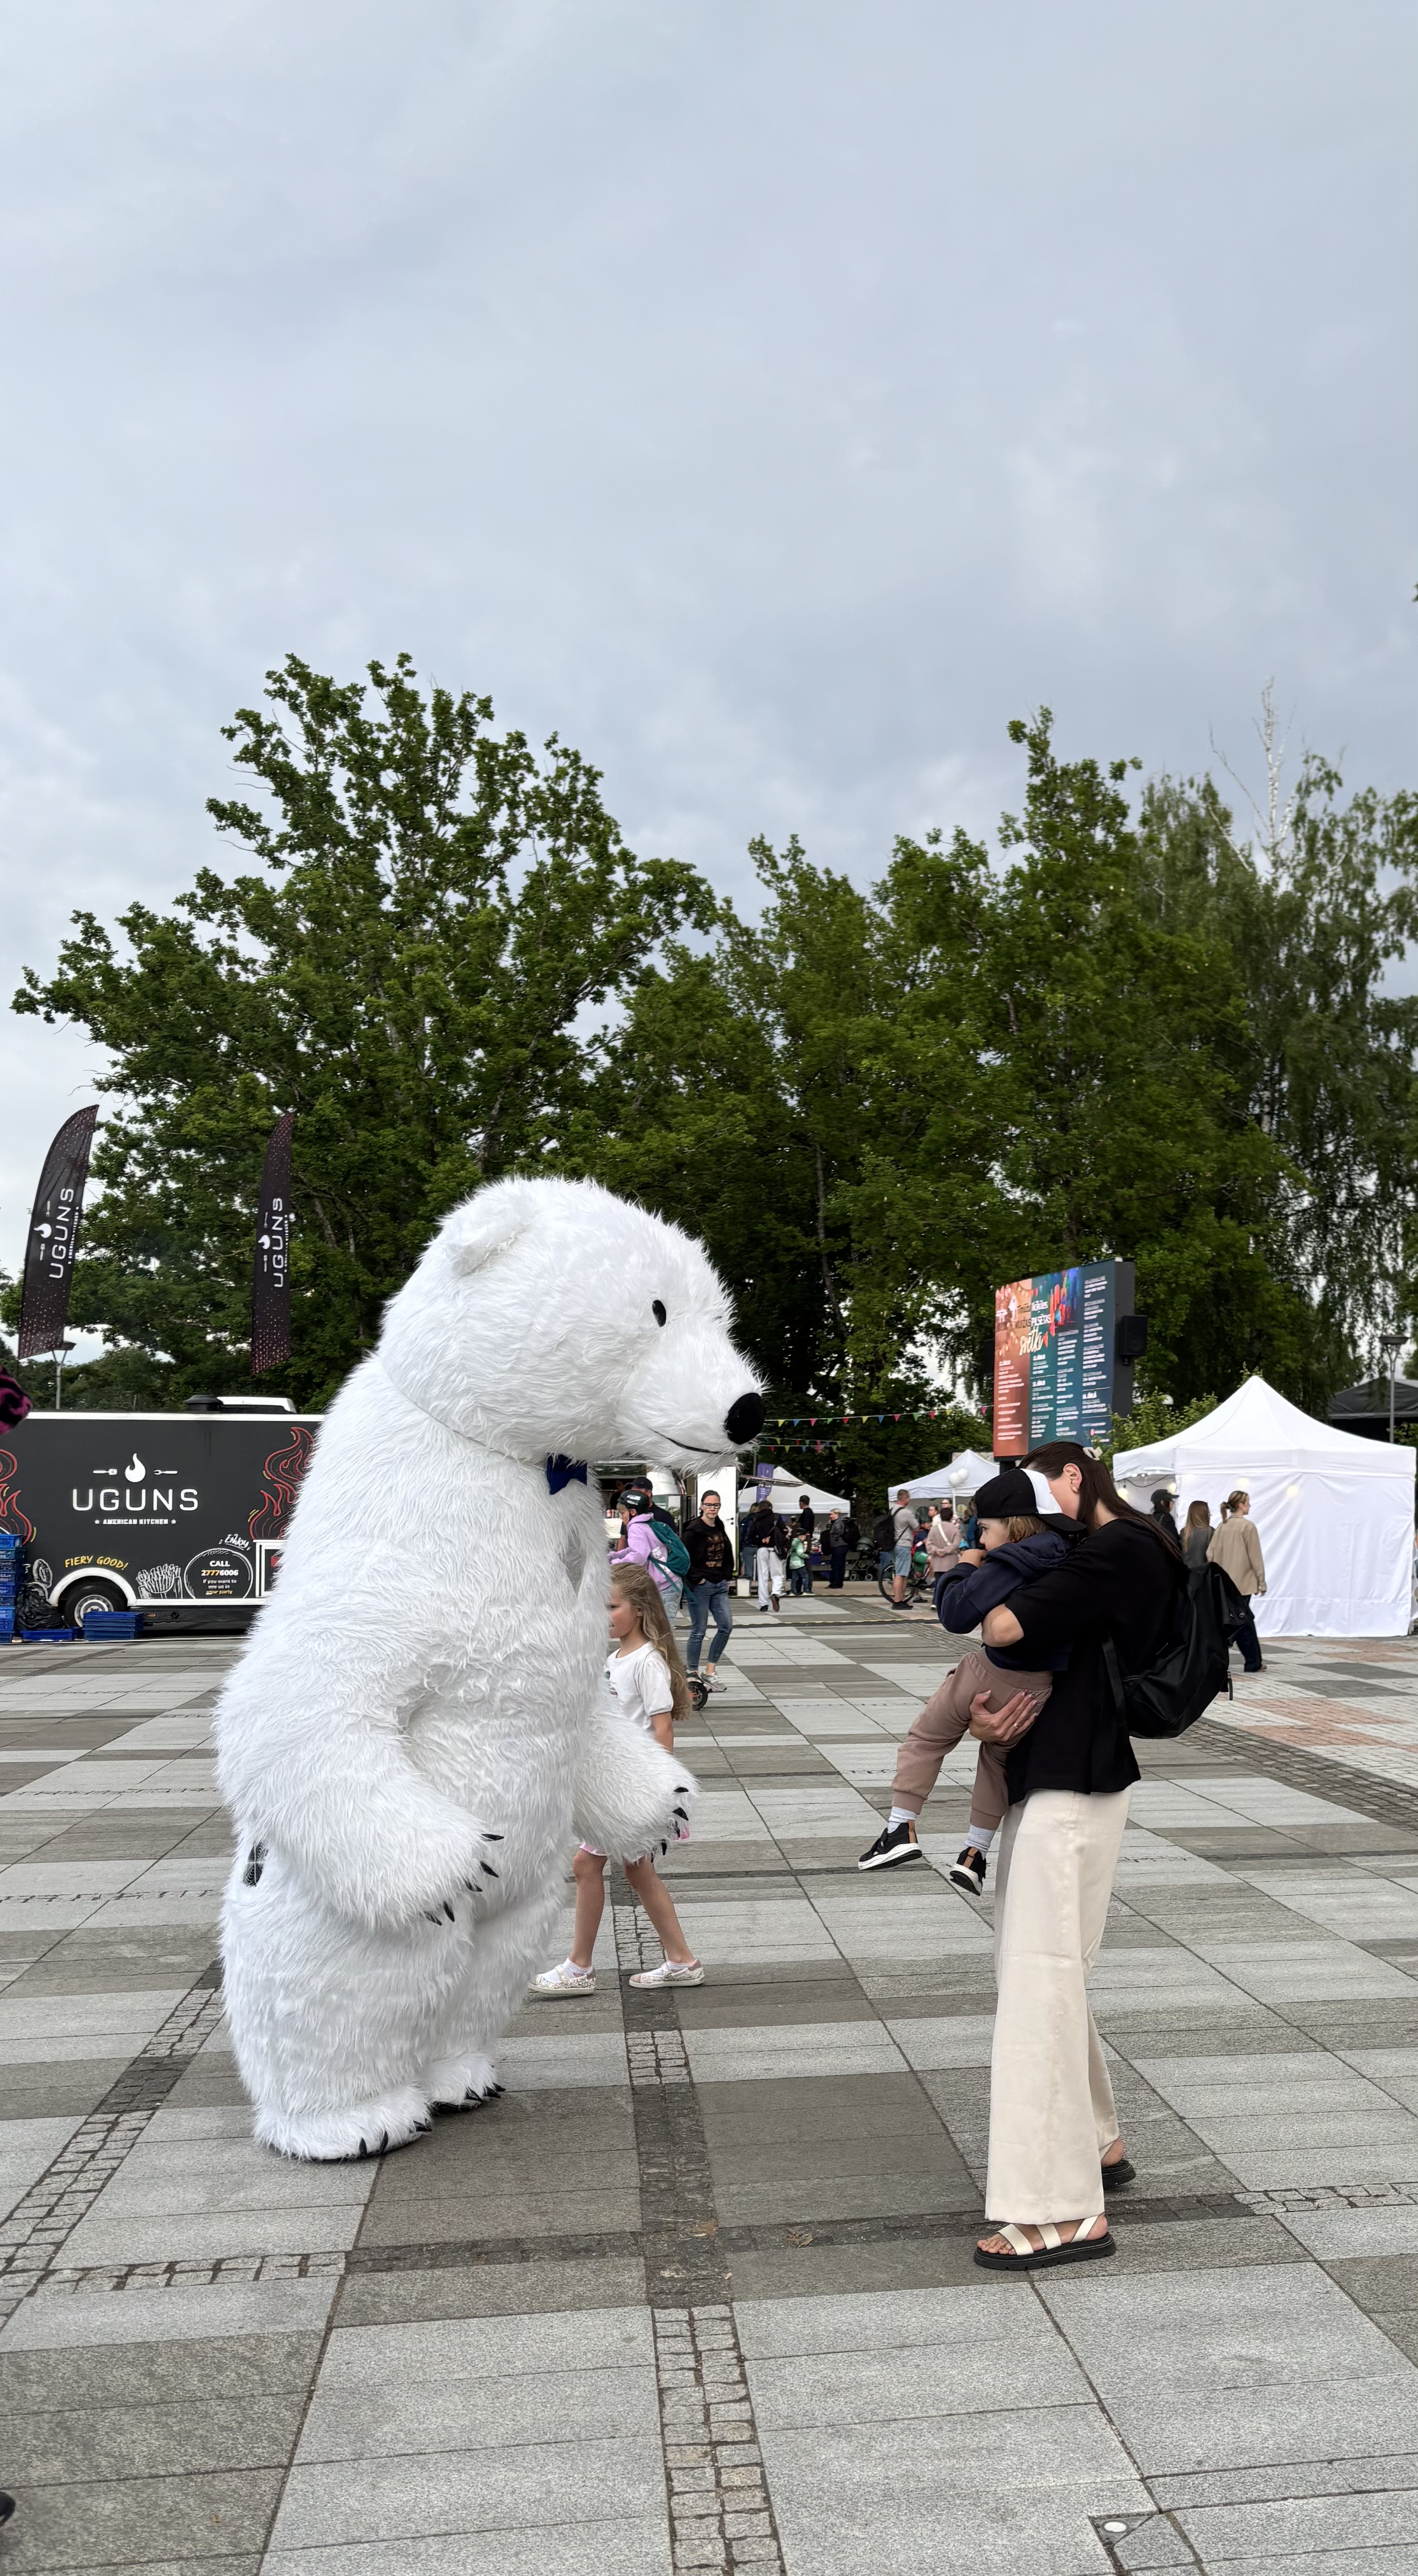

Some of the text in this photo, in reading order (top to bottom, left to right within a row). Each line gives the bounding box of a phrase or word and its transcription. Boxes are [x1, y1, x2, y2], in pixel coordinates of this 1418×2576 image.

[49, 1189, 74, 1278] UGUNS
[272, 1198, 283, 1287] UGUNS
[73, 1489, 199, 1511] UGUNS
[64, 1555, 129, 1570] FIERY GOOD!
